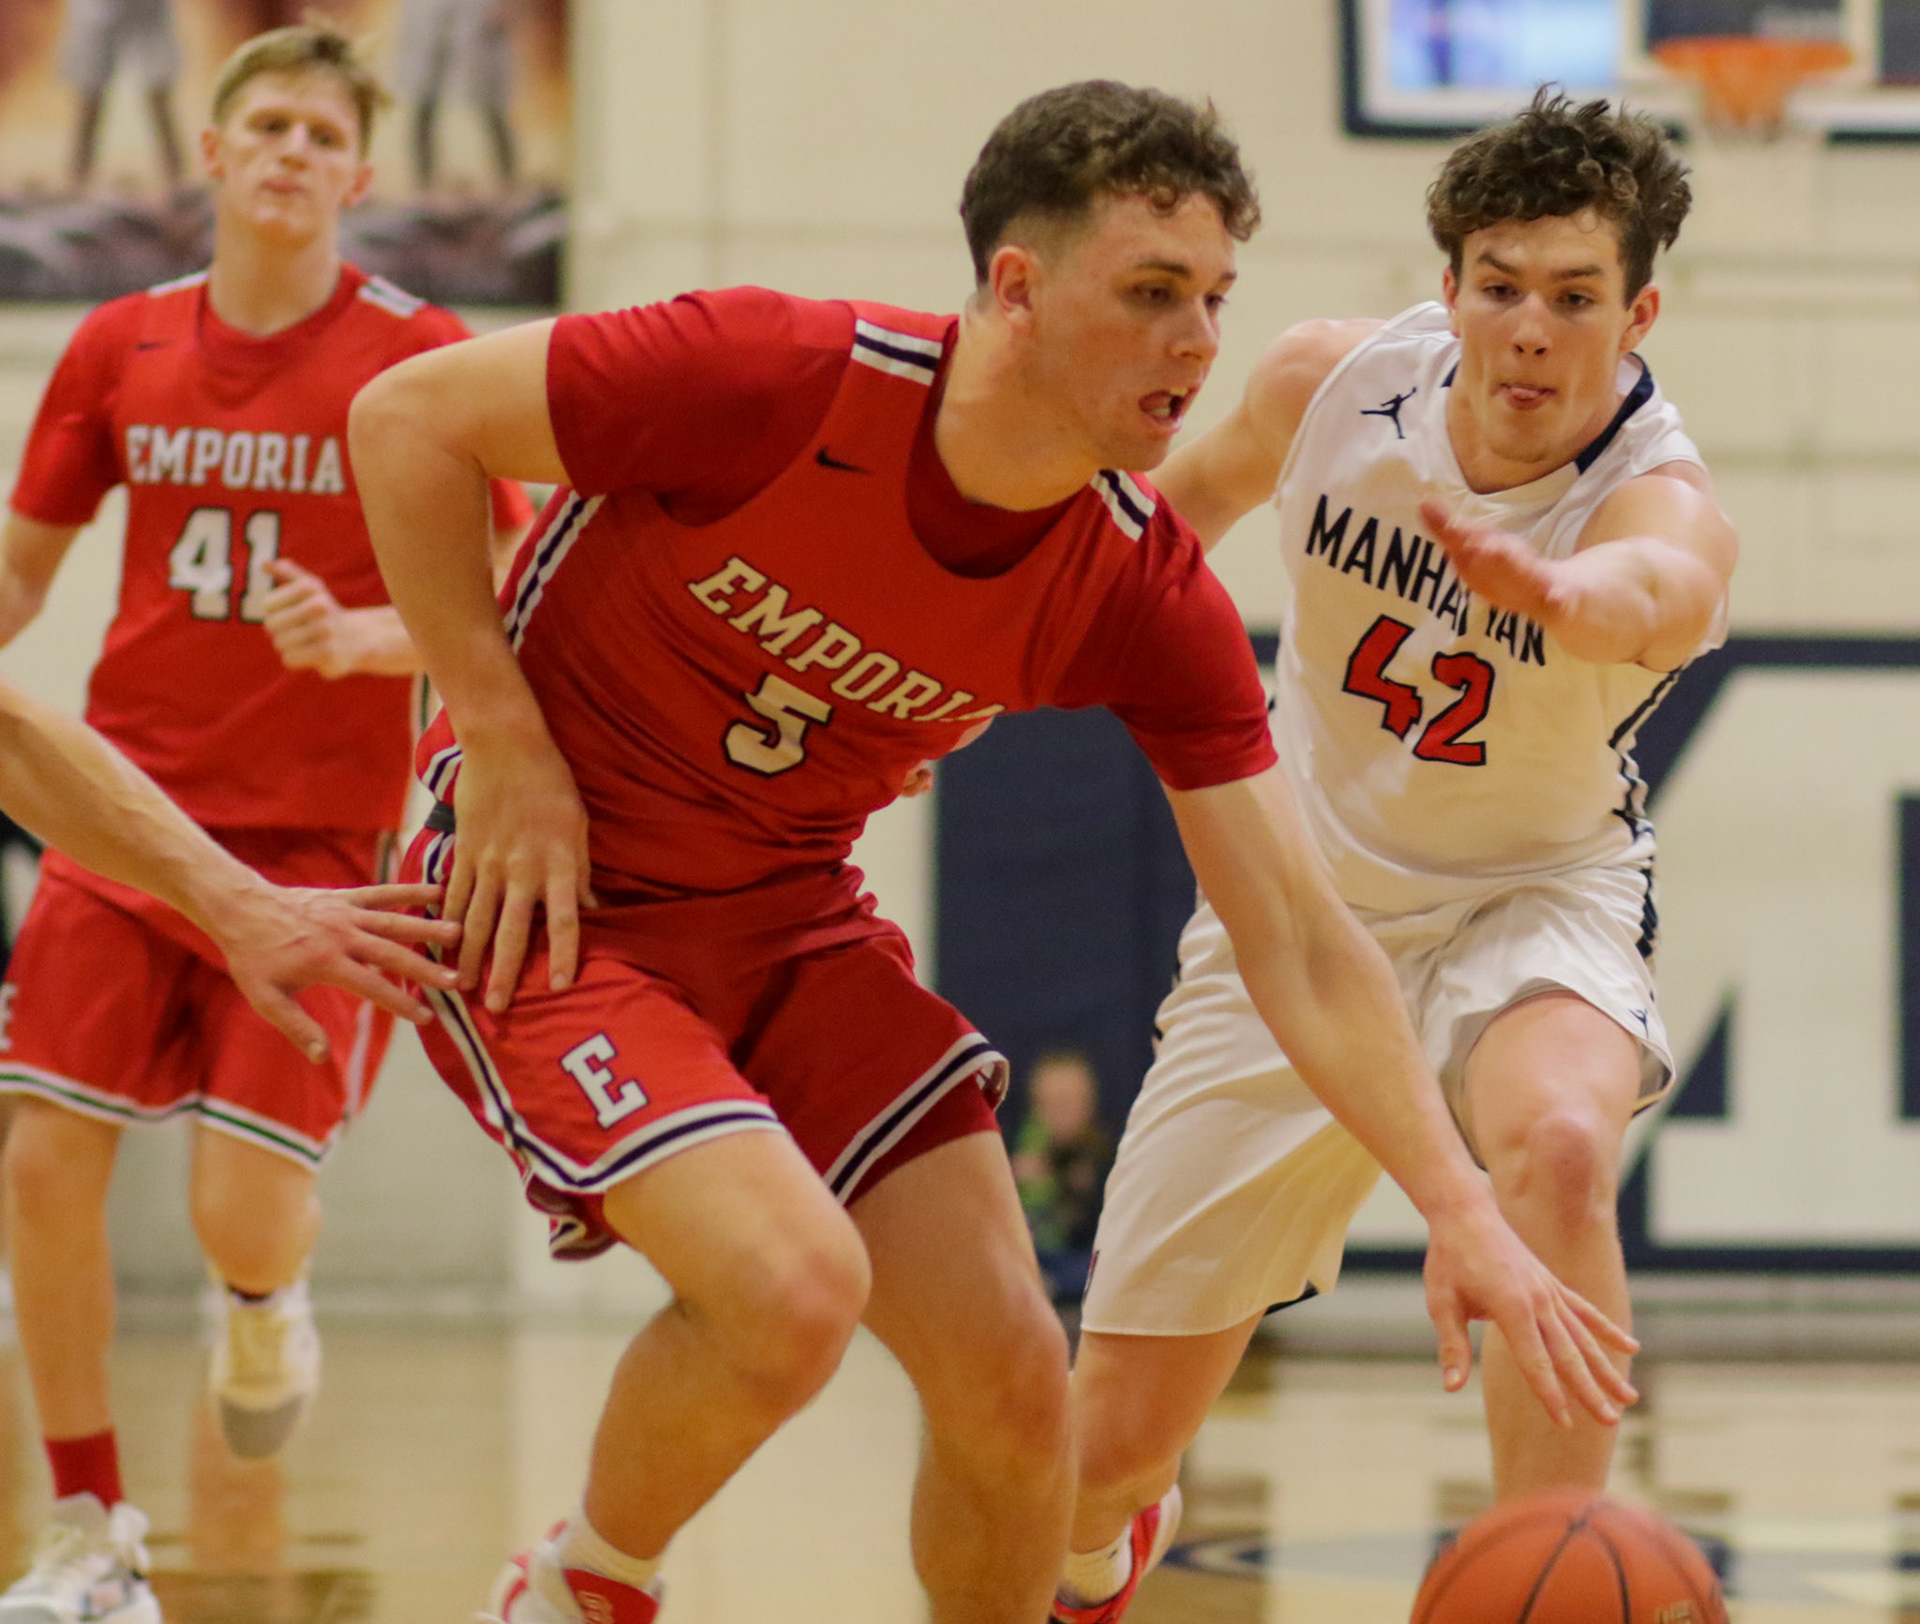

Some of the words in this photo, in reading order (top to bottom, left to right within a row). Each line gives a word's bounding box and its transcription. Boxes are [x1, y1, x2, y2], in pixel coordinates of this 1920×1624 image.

[126, 423, 346, 496] EMPORIA
[168, 505, 282, 624] 41
[1305, 493, 1546, 667] MANHAAN
[721, 670, 835, 778] 5
[1341, 613, 1496, 767] 42
[558, 1030, 650, 1132] E
